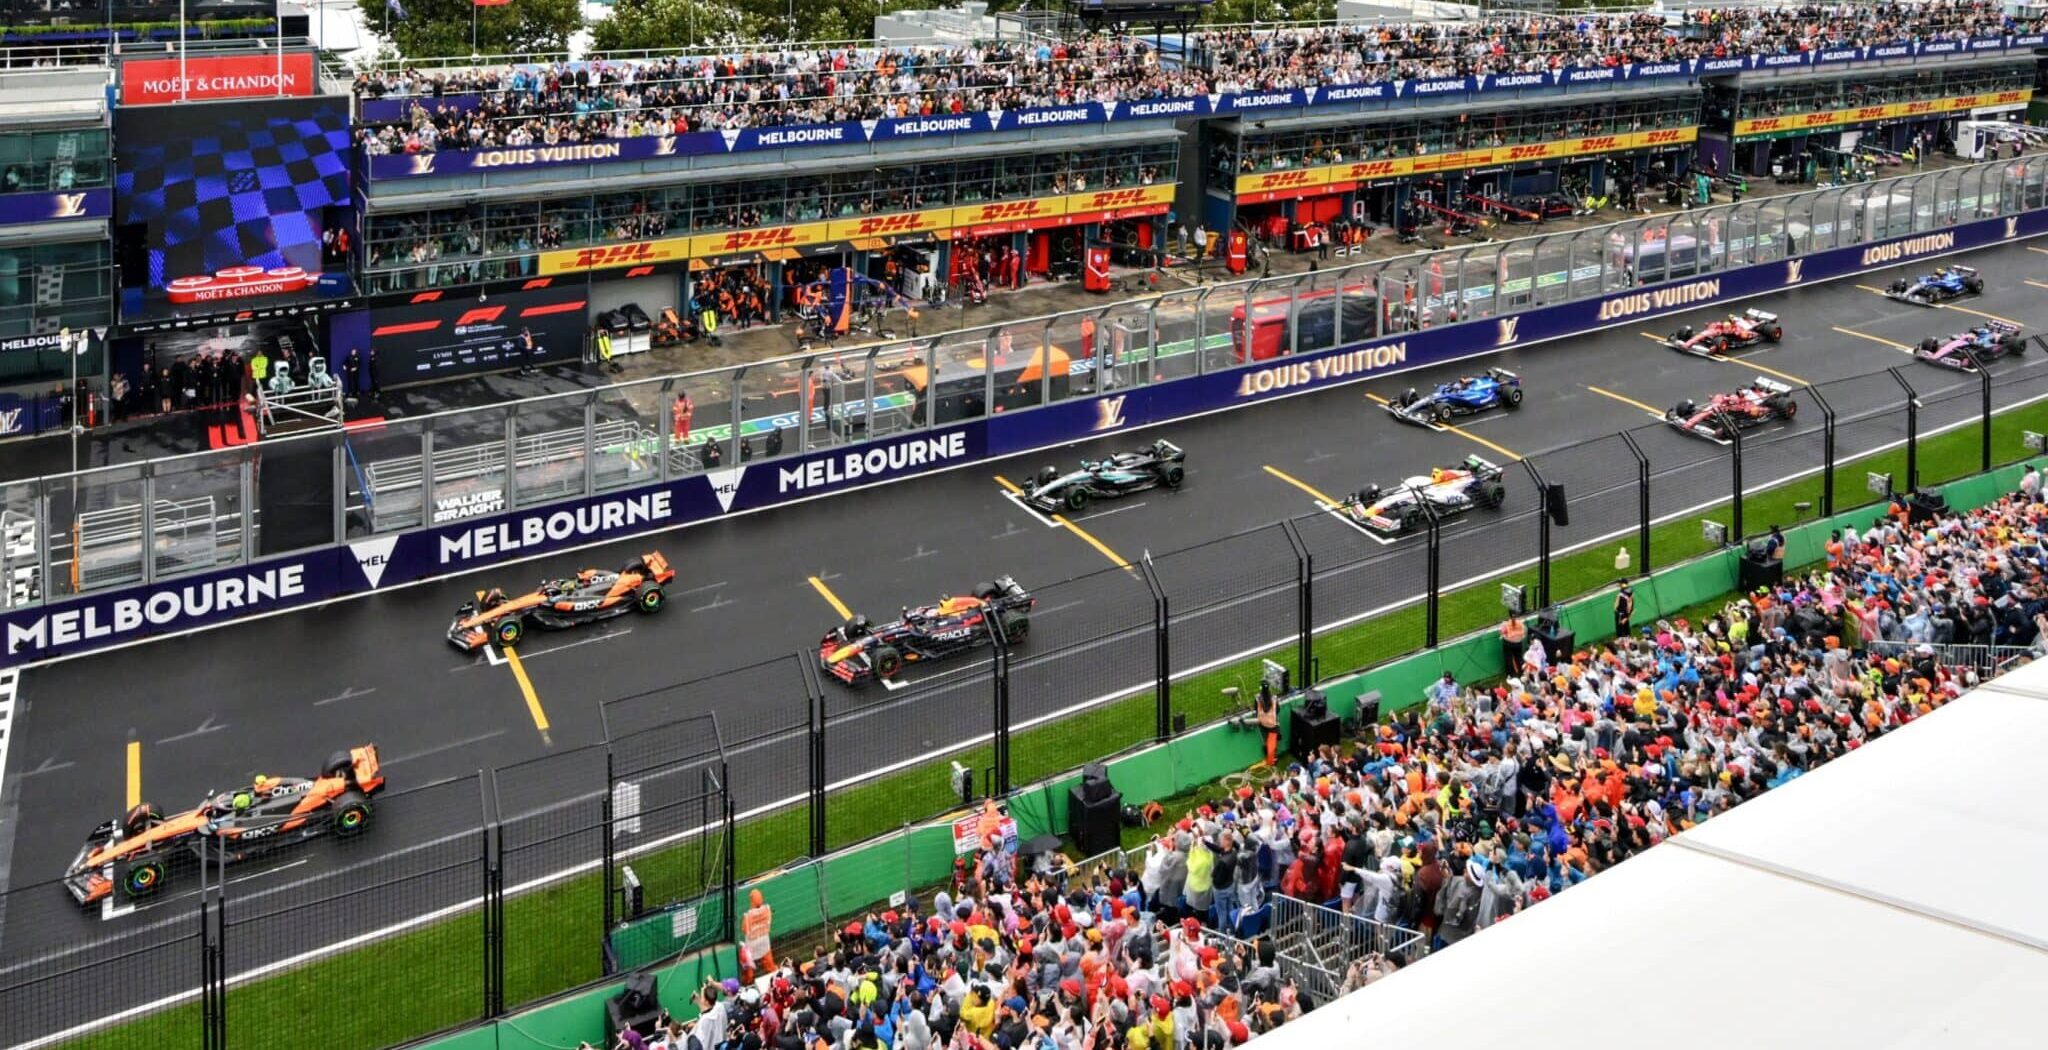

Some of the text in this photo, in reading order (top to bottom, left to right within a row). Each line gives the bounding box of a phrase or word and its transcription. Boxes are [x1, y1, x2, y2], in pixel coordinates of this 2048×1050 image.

[1822, 50, 1856, 61] MELBOURNE
[1875, 46, 1908, 56] MELBOURNE
[1704, 59, 1743, 70] MELBOURNE
[1765, 54, 1801, 65] MELBOURNE
[1570, 69, 1613, 80] MELBOURNE
[1640, 64, 1681, 75] MELBOURNE
[143, 74, 295, 94] MOËT & CHANDON
[1415, 80, 1465, 93] MELBOURNE
[1495, 75, 1543, 87] MELBOURNE
[1328, 86, 1383, 100] MELBOURNE
[1998, 92, 2021, 103] DHL
[1233, 94, 1292, 107] MELBOURNE
[1907, 101, 1933, 113] DHL
[1952, 97, 1978, 108] DHL
[1130, 101, 1194, 115] MELBOURNE
[1858, 107, 1885, 119] DHL
[1018, 109, 1088, 124] MELBOURNE
[1806, 112, 1833, 125] DHL
[894, 118, 971, 134] MELBOURNE
[1750, 119, 1780, 131] DHL
[758, 128, 843, 145] MELBOURNE
[1647, 130, 1680, 143] DHL
[1580, 137, 1616, 151] DHL
[476, 143, 620, 167] LOUIS VUITTON
[1509, 144, 1547, 159] DHL
[1350, 162, 1394, 177] DHL
[1261, 171, 1309, 188] DHL
[1092, 189, 1146, 207] DHL
[980, 201, 1040, 220] DHL
[858, 213, 924, 234] DHL
[724, 228, 796, 250] DHL
[575, 243, 656, 267] DHL
[1862, 232, 1955, 265] LOUIS VUITTON
[226, 288, 234, 297] &
[234, 283, 283, 296] CHANDON
[1600, 279, 1720, 321] LOUIS VUITTON
[1239, 342, 1407, 396] LOUIS VUITTON
[779, 431, 966, 493] MELBOURNE
[714, 484, 737, 494] MEL
[437, 490, 503, 510] WALKER
[434, 500, 505, 523] STRAIGHT
[440, 490, 672, 564] MELBOURNE
[360, 555, 388, 567] MEL
[7, 564, 305, 655] MELBOURNE
[271, 781, 314, 797] Chrome
